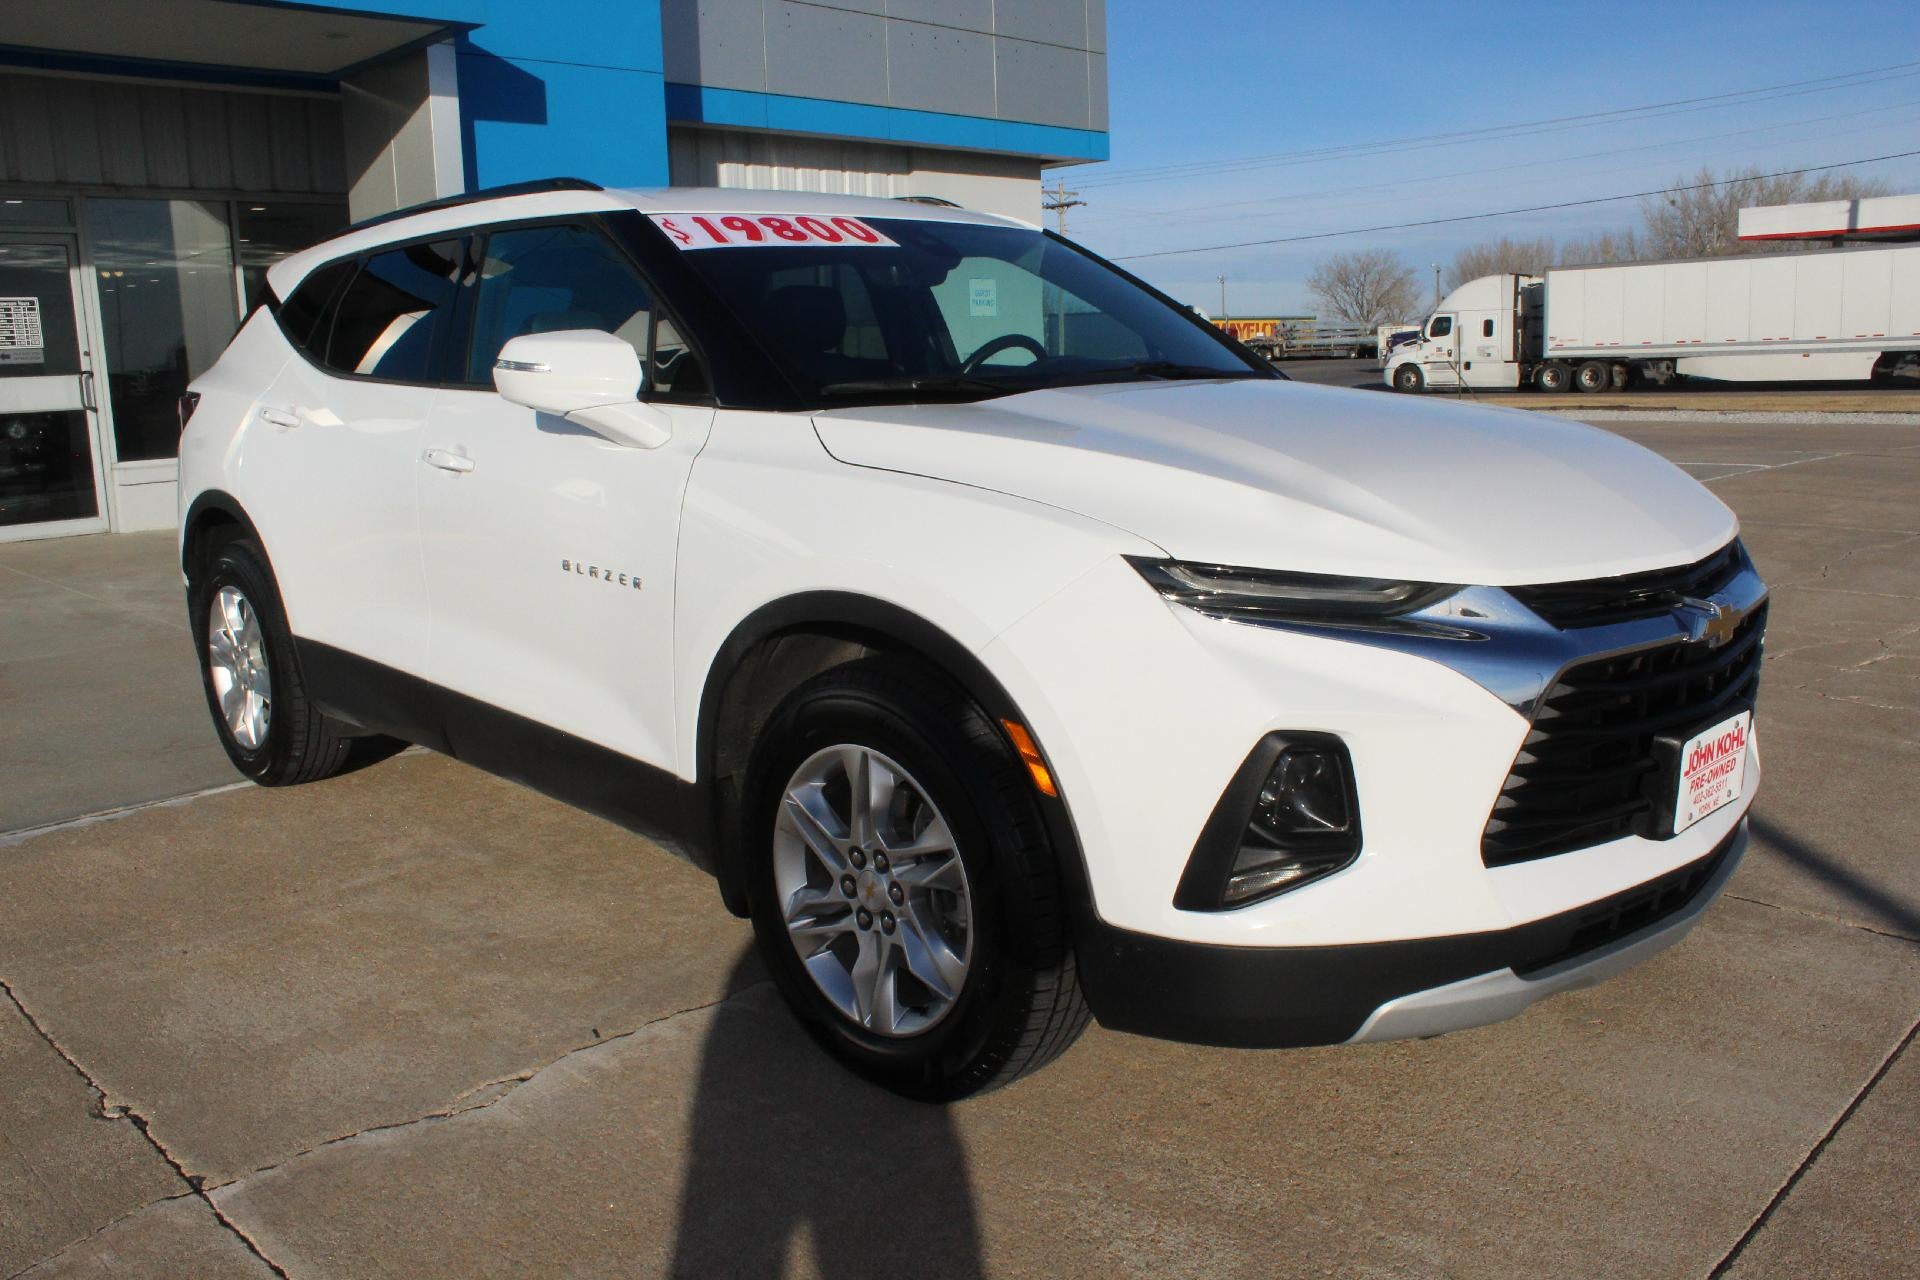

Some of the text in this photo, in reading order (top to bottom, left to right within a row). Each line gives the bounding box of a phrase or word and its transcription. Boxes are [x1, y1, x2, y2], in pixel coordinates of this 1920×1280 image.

[562, 560, 642, 590] BLAZER
[1684, 726, 1745, 777] JOHN KOHL
[1689, 757, 1737, 794] PRE-OWNED
